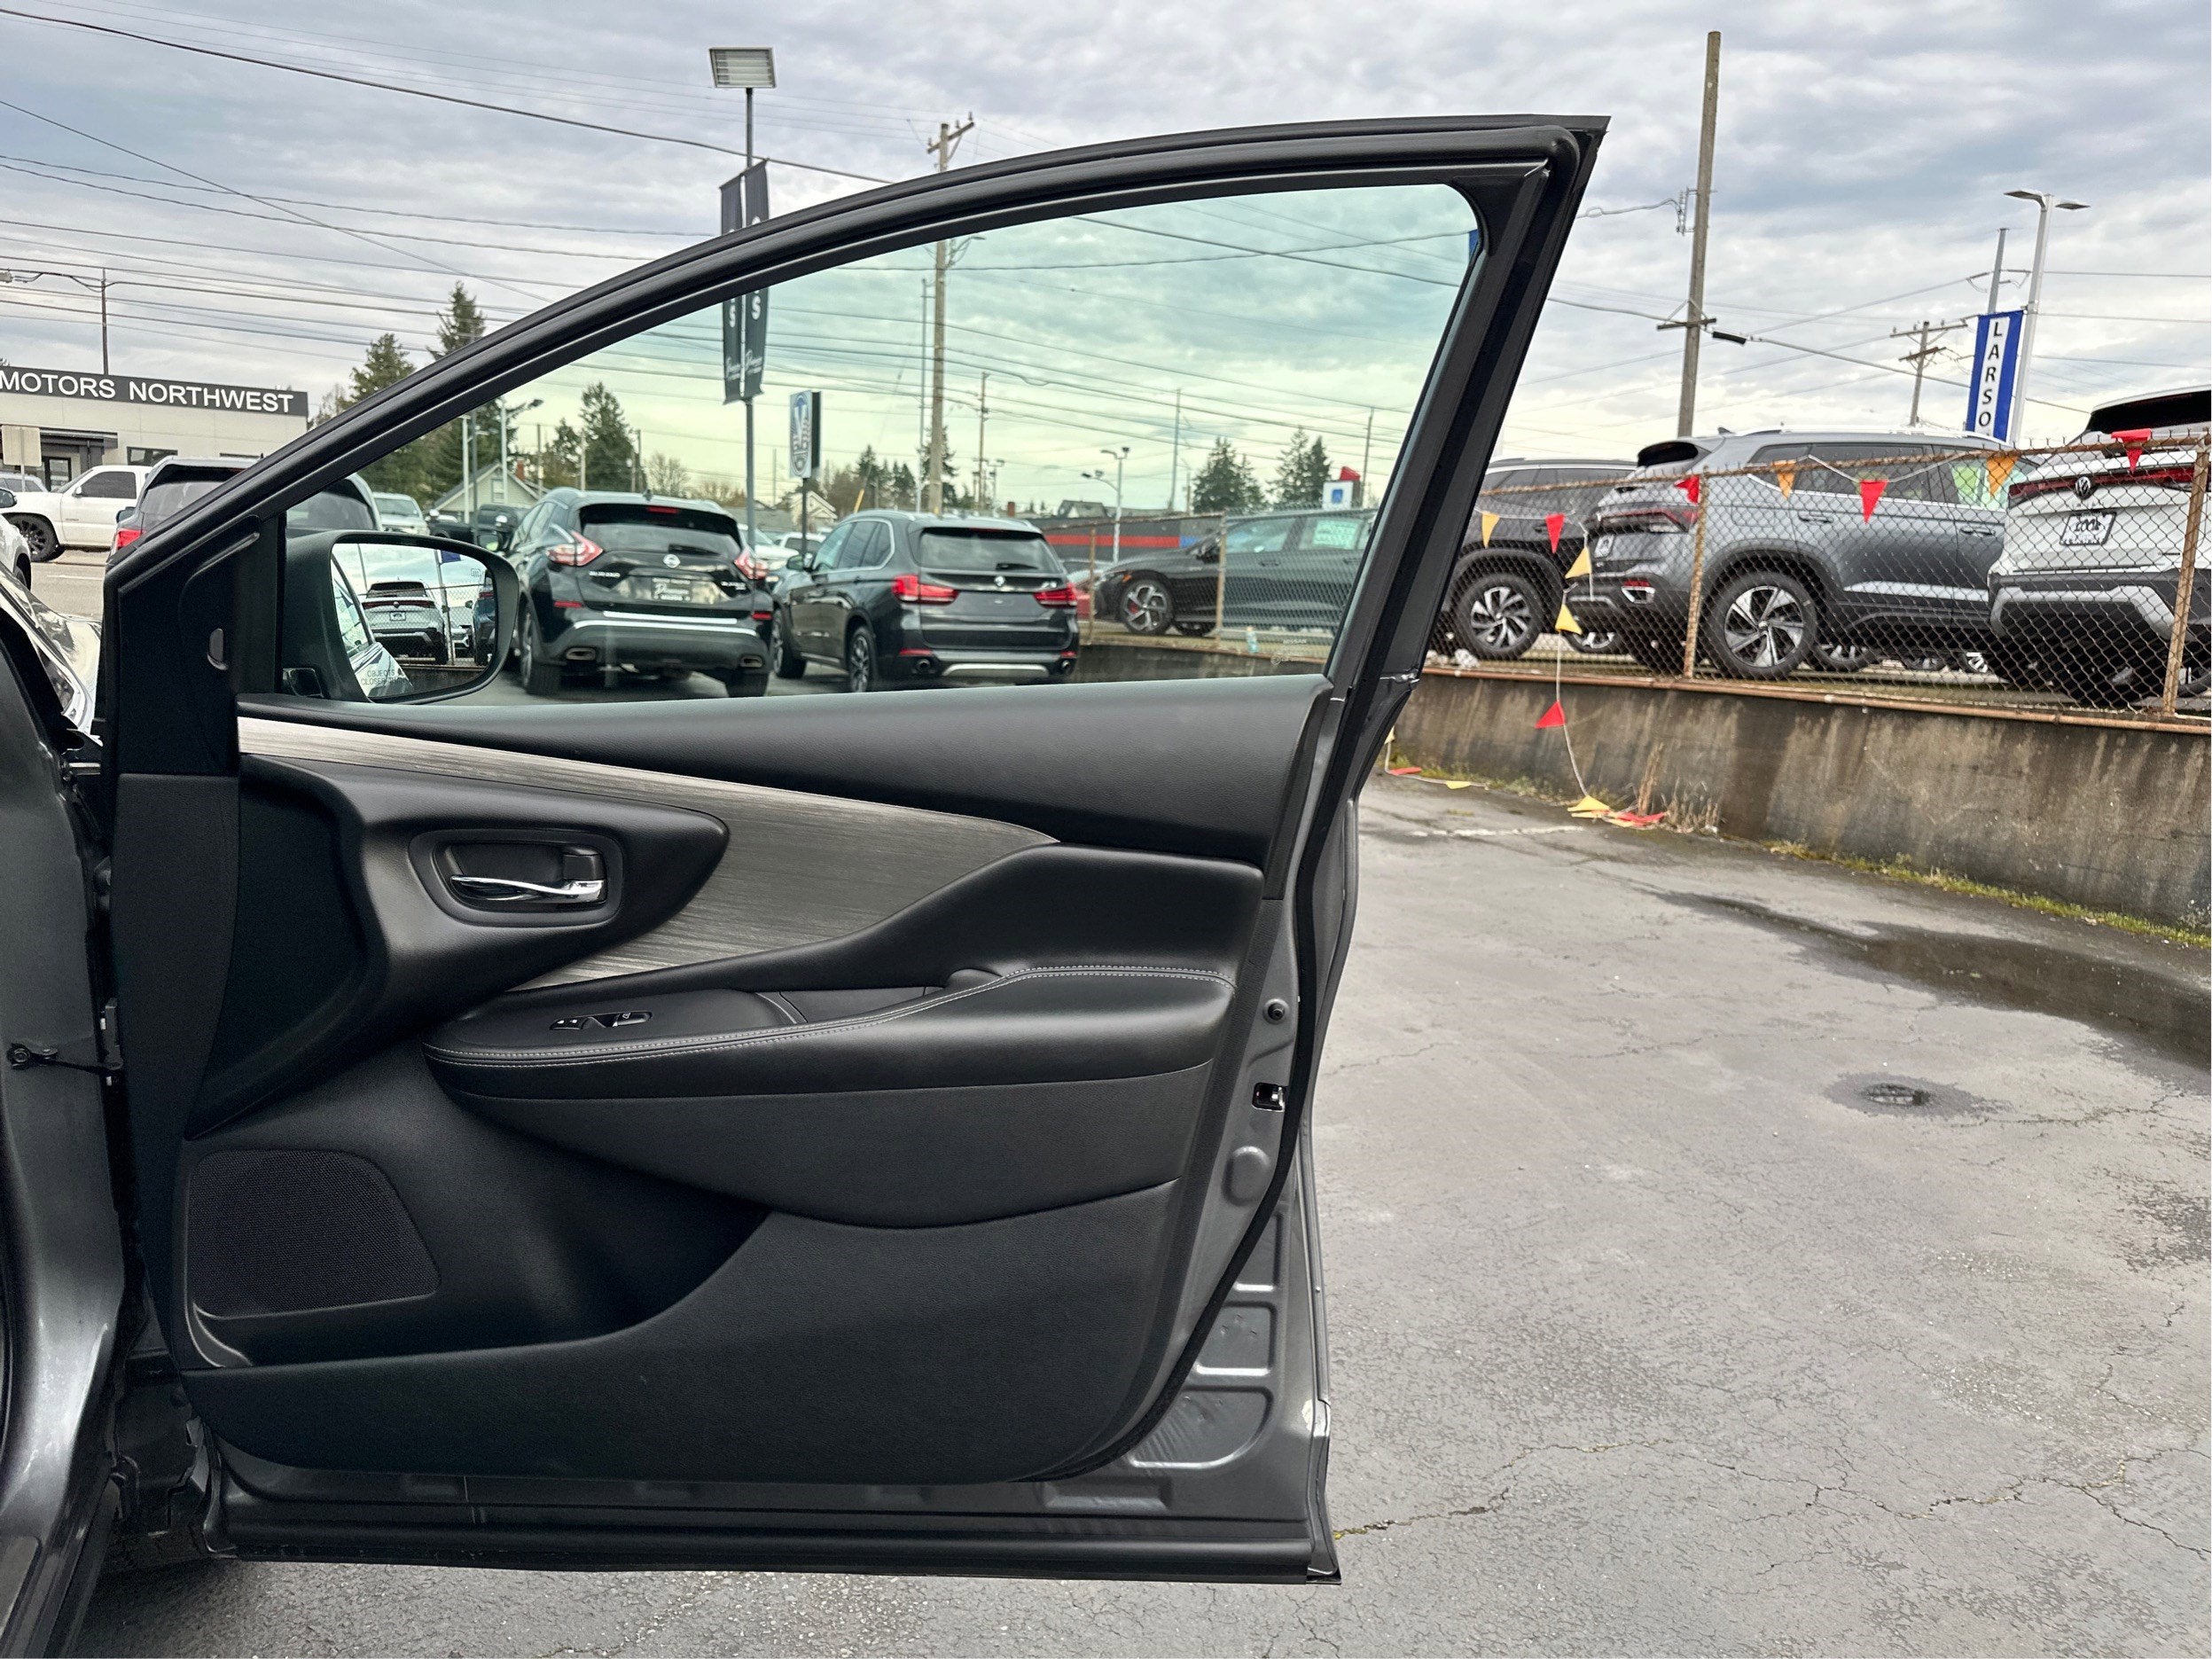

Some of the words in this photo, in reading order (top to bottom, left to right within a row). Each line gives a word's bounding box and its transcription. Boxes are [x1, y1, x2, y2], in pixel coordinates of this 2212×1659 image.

[0, 370, 116, 399] MOTORS
[129, 380, 293, 413] NORTHWEST
[1978, 321, 2002, 436] LARSO
